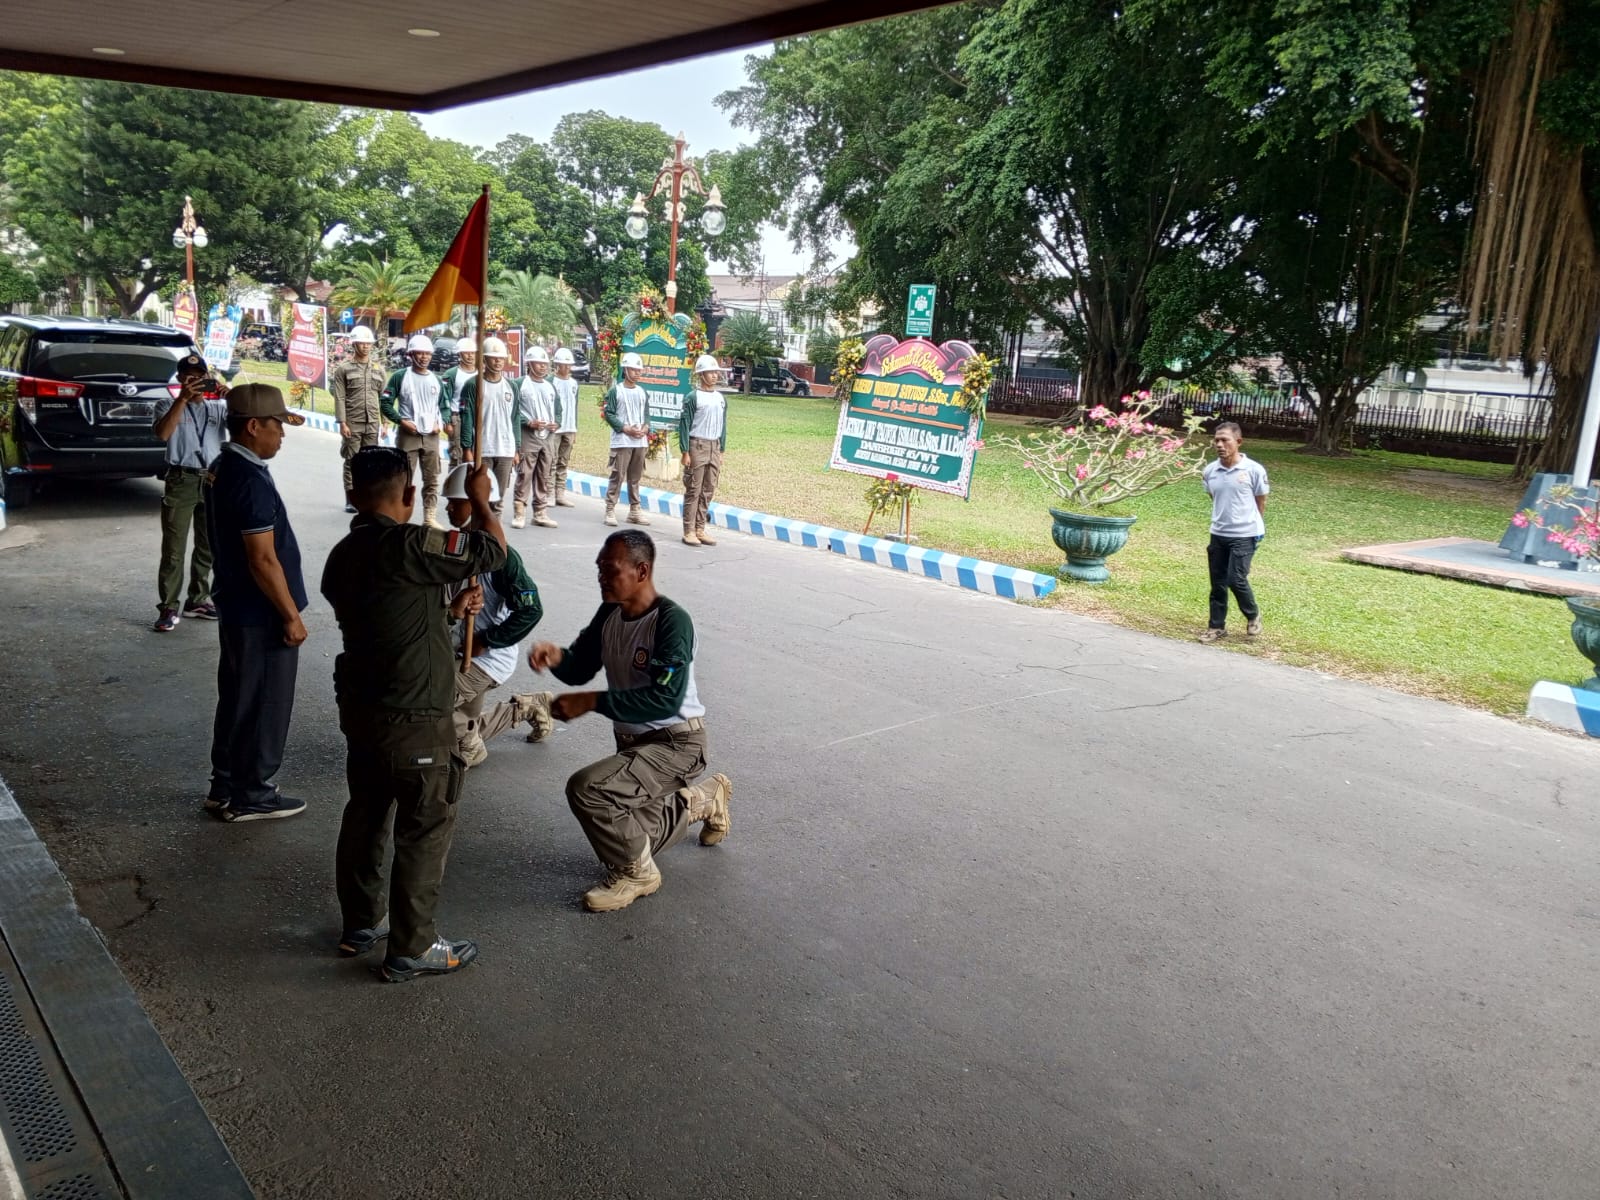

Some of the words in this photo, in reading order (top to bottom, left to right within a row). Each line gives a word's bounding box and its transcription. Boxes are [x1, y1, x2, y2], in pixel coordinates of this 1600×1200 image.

[342, 310, 351, 322] P
[881, 349, 914, 376] Selamat
[918, 351, 945, 384] Sukses
